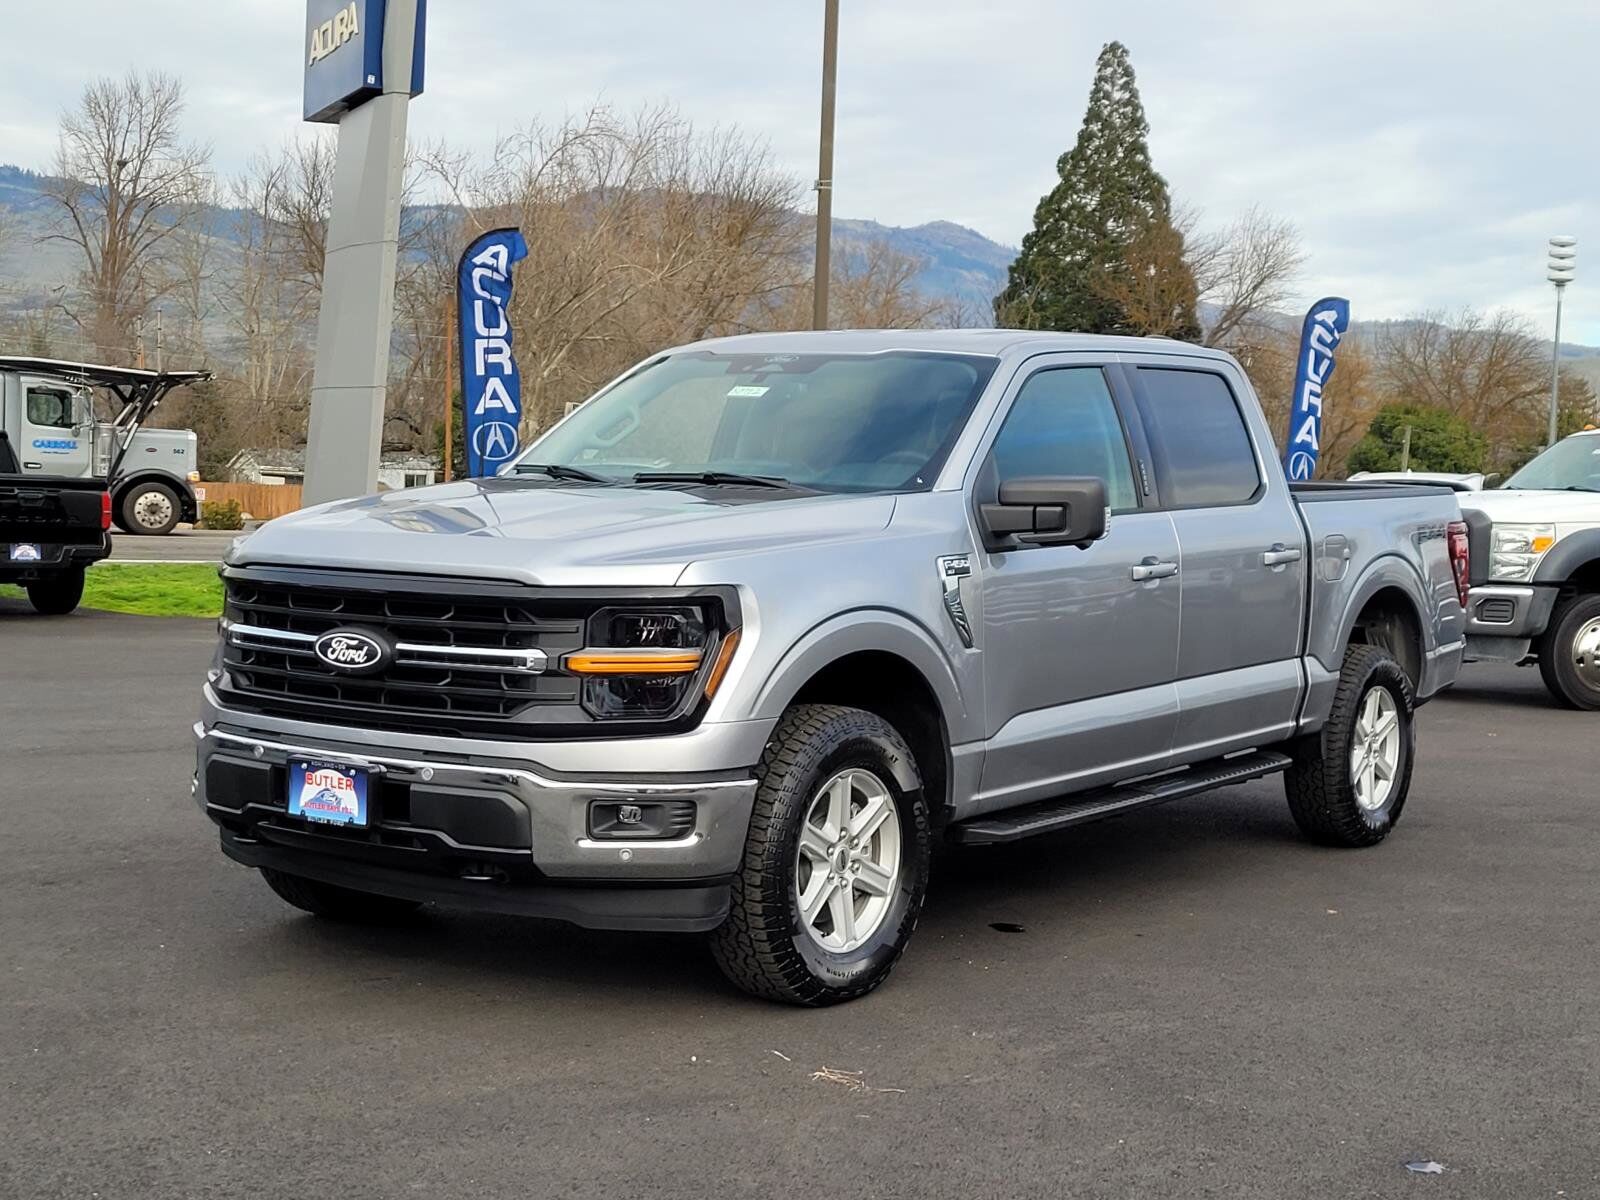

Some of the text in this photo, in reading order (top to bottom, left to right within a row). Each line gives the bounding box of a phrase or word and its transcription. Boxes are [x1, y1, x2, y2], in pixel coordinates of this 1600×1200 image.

[309, 1, 359, 67] ACURA
[472, 244, 517, 414] ACURA
[32, 439, 79, 449] CARROLL
[327, 636, 369, 663] Ford
[305, 771, 353, 791] BUTLER
